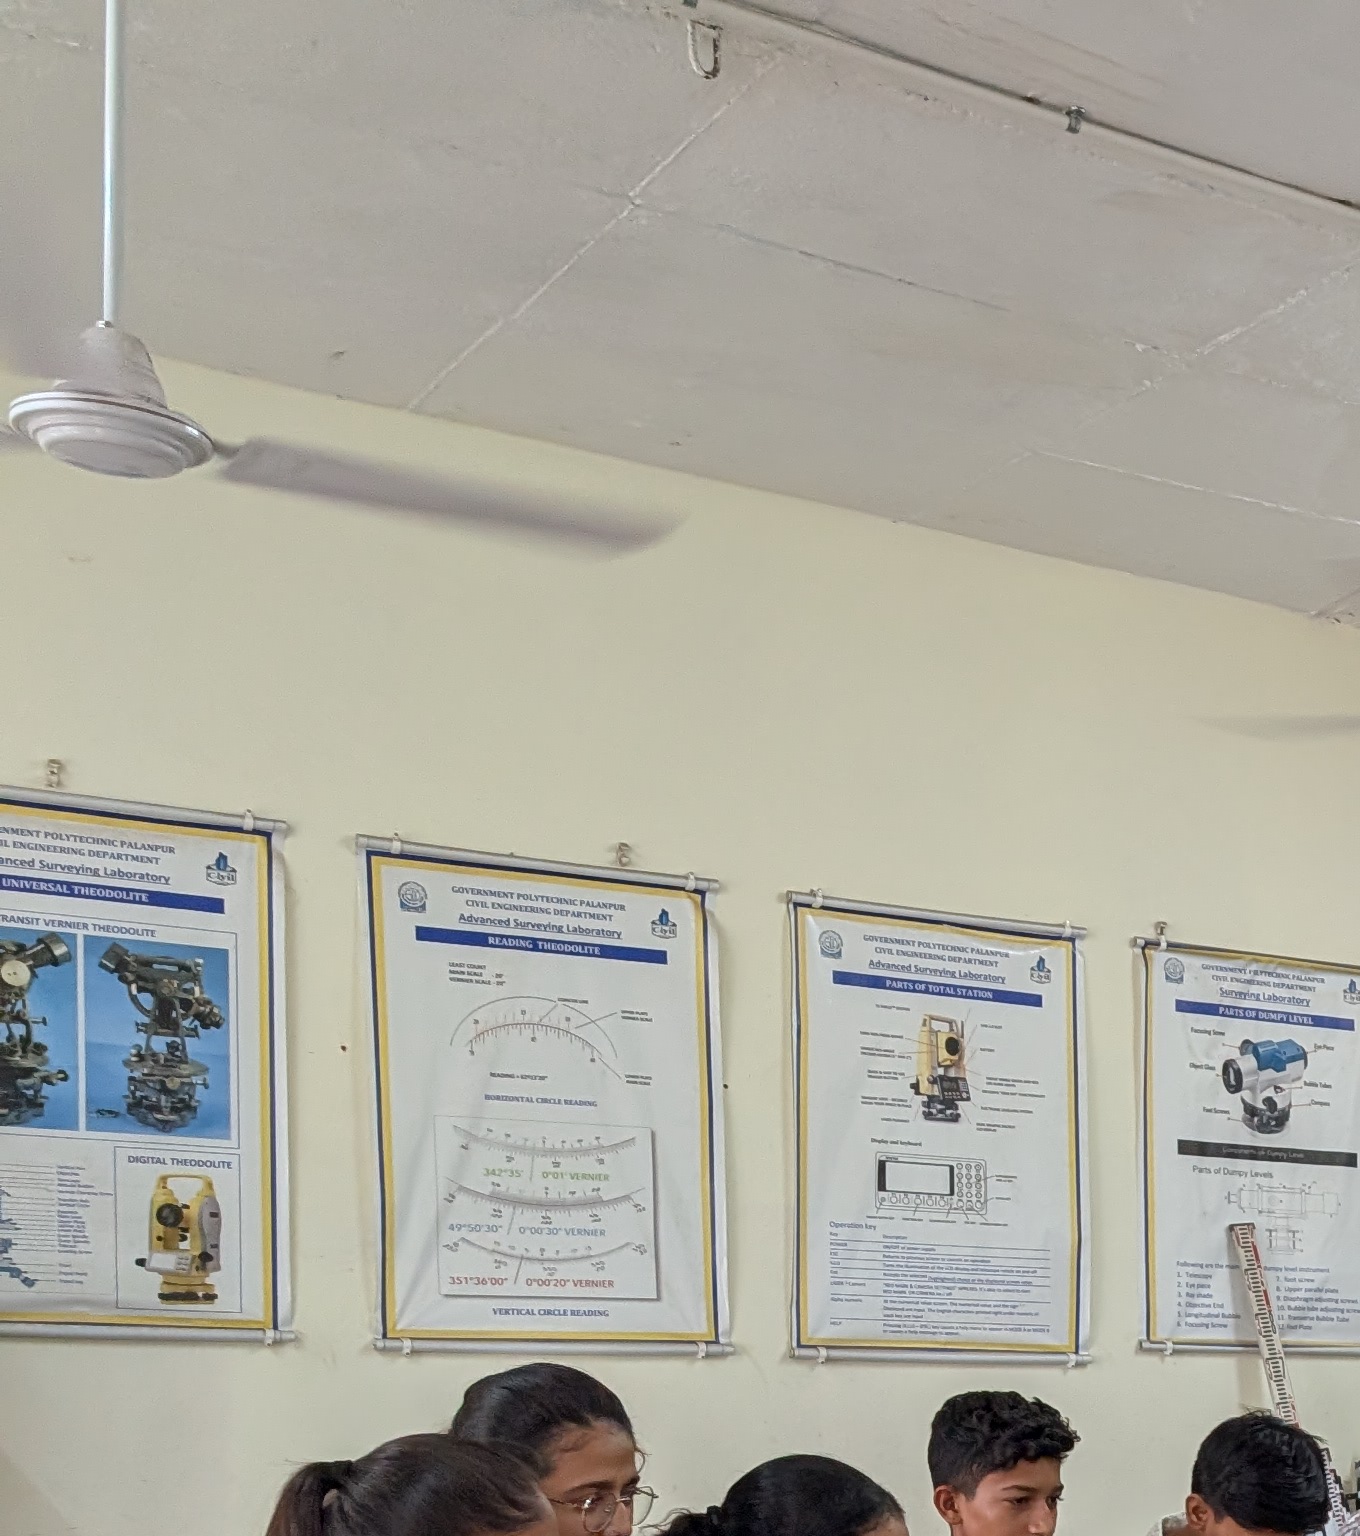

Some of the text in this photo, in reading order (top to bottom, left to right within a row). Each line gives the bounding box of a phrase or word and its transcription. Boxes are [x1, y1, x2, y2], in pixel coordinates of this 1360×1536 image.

[44, 831, 118, 847] POLYTECHNIC
[120, 840, 175, 854] PALANPUR
[13, 841, 85, 857] ENGINEERING
[88, 849, 161, 865] DEPARTMENT
[39, 860, 100, 877] Surveying
[104, 867, 171, 885] Laboratory
[2, 878, 149, 902] UNIVERSAL THEODOLITE
[452, 885, 626, 912] GOVERNMENT POLYTECHNIC PALANPUR
[466, 899, 613, 922] CIVIL ENGINEERING DEPARTMENT
[44, 919, 89, 931] VERNIER
[91, 923, 156, 938] THEODOLITE
[459, 912, 623, 940] Advanced Surveying Laboratory
[488, 935, 600, 955] READING THEODOLITE
[863, 934, 1010, 958] GOVERNMENT POLYTECHNIC PALANPUR
[874, 946, 998, 968] CIVIL ENGINEERING DEPARTMENT
[868, 959, 1006, 984] Advanced Surveying Laboratory
[1201, 963, 1247, 975] GOVERNMENT
[1291, 974, 1325, 984] PALANPUR
[886, 979, 993, 999] PARTS OF TOTAL STATION
[1230, 976, 1271, 989] ENGINEERING
[1272, 981, 1316, 992] DEPARTMENT
[1219, 987, 1310, 1007] Surveying Laboratory
[1219, 1006, 1313, 1025] PARTS OF DUMPY LEVEL
[484, 1094, 598, 1107] HORIZONTAL CIRCLE READING
[128, 1155, 233, 1170] DIGITAL THEODOLITE
[1192, 1165, 1273, 1179] Parts of Dumpy Levels
[570, 1172, 609, 1181] VERNIER
[565, 1228, 606, 1236] VERNIER
[829, 1221, 863, 1229] Operation
[572, 1279, 614, 1288] VERNIER
[492, 1307, 609, 1317] VERTICAL CIRCLE READING
